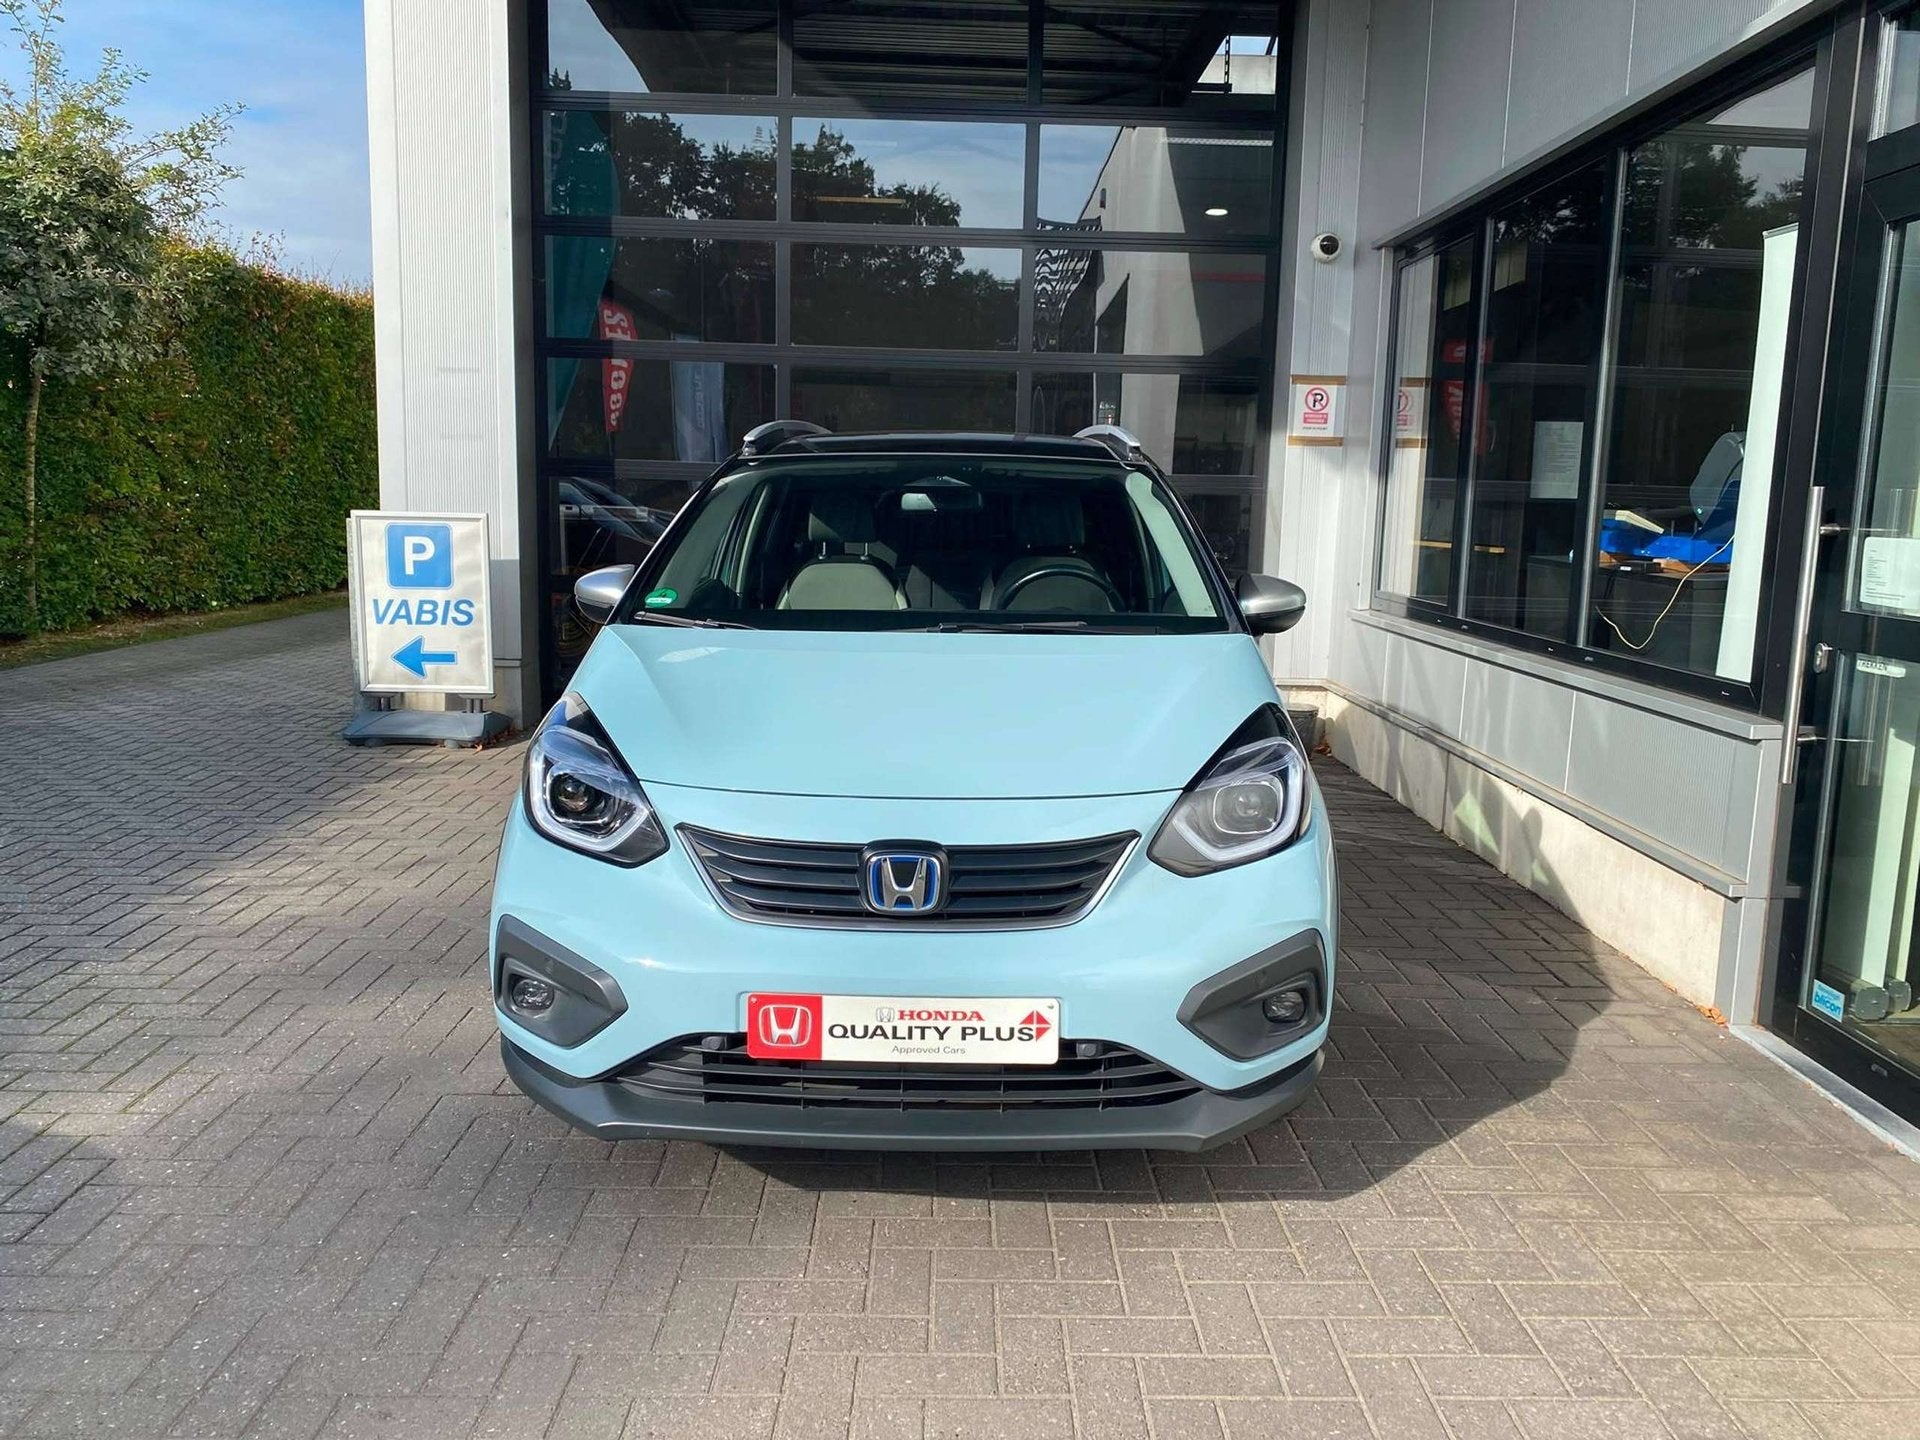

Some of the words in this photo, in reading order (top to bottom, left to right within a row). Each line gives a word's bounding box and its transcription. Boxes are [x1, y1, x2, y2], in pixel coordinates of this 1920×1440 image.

[403, 536, 435, 575] P
[372, 599, 475, 626] VABIS
[897, 1009, 985, 1022] HONDA
[828, 1024, 955, 1041] QUALITY
[961, 1026, 1035, 1042] PLUS
[892, 1045, 940, 1055] Approved
[943, 1046, 966, 1055] Cars
